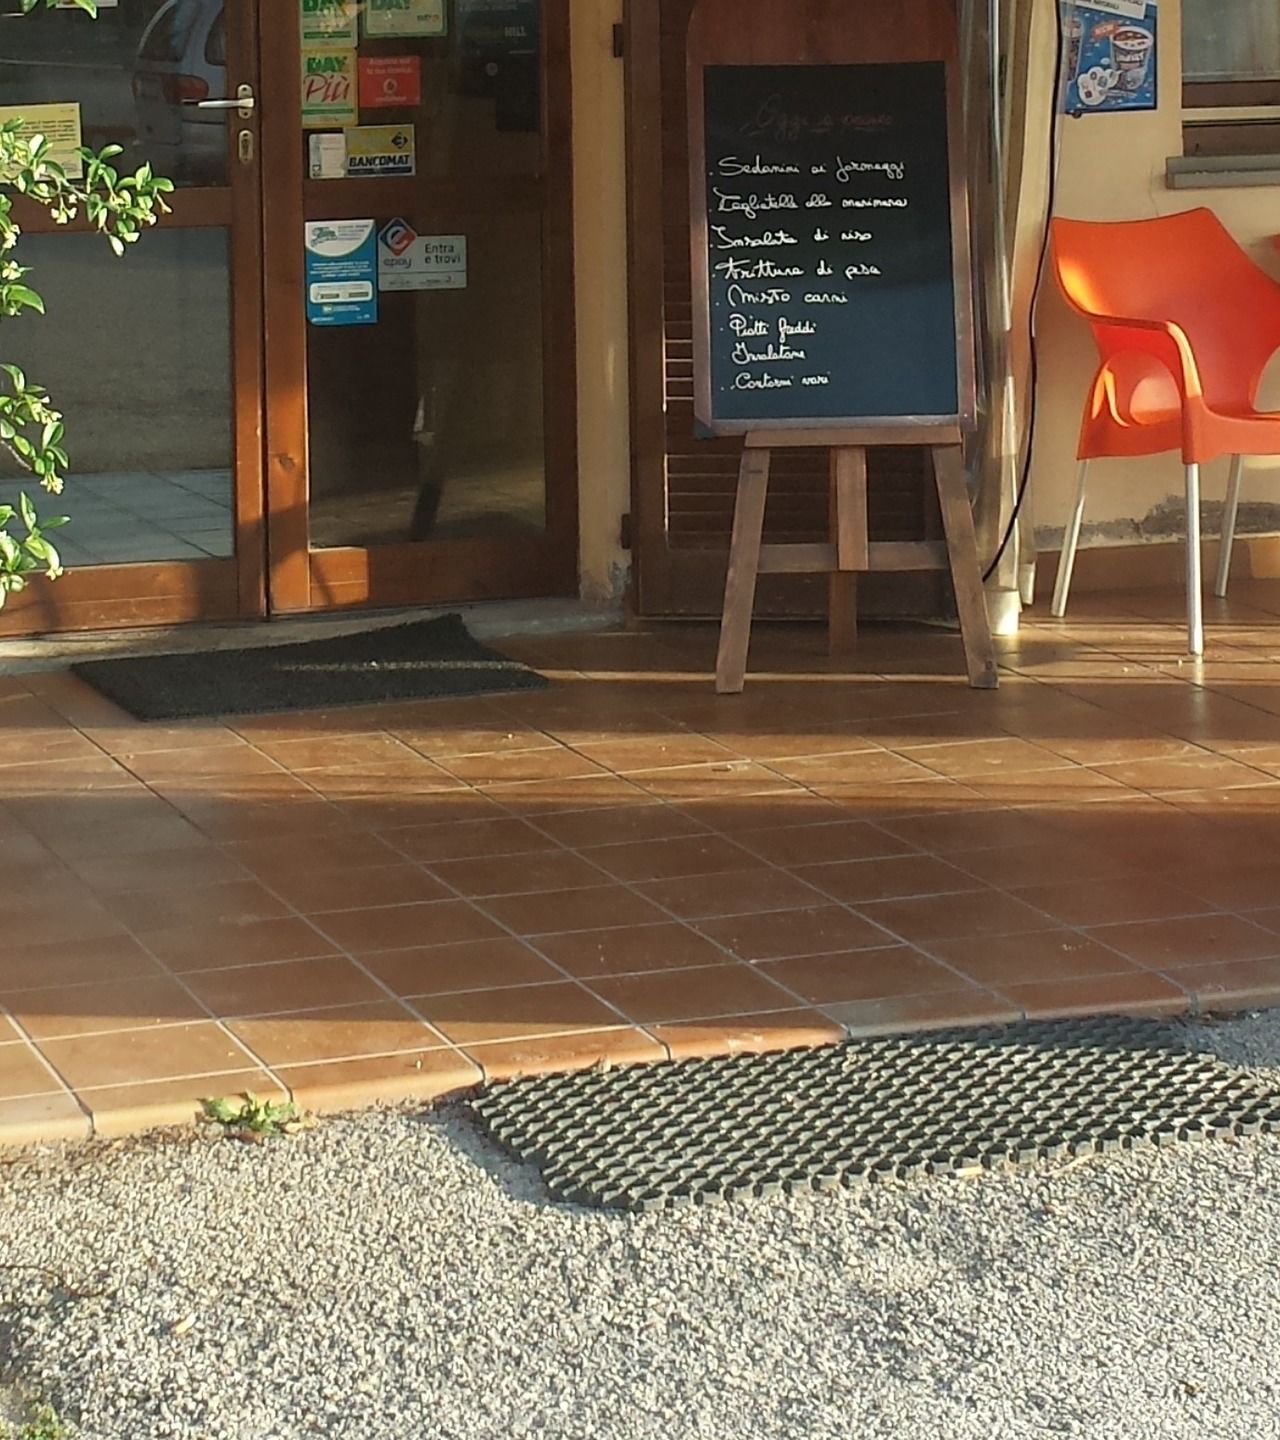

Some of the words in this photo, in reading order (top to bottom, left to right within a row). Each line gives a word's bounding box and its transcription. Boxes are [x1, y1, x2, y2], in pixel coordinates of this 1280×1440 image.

[307, 56, 348, 73] DAY
[303, 73, 350, 103] Più
[349, 155, 410, 167] BANCOMAT
[718, 155, 800, 177] Sedanini
[811, 162, 828, 174] ai
[835, 155, 905, 183] formaggi
[713, 186, 799, 219] Tagliatelle
[711, 224, 798, 249] Insalata
[813, 227, 830, 242] di
[840, 229, 873, 241] riso
[424, 243, 455, 254] Entra
[424, 255, 432, 264] e
[434, 254, 461, 264] trovi
[383, 258, 412, 269] epay
[816, 259, 834, 276] di
[727, 283, 792, 308] Misto
[804, 291, 849, 304] carni
[729, 313, 770, 337] Piatti
[778, 316, 818, 344] freddi
[731, 341, 806, 366] Insalatone
[735, 372, 796, 390] Contorni
[801, 371, 832, 386] vari
